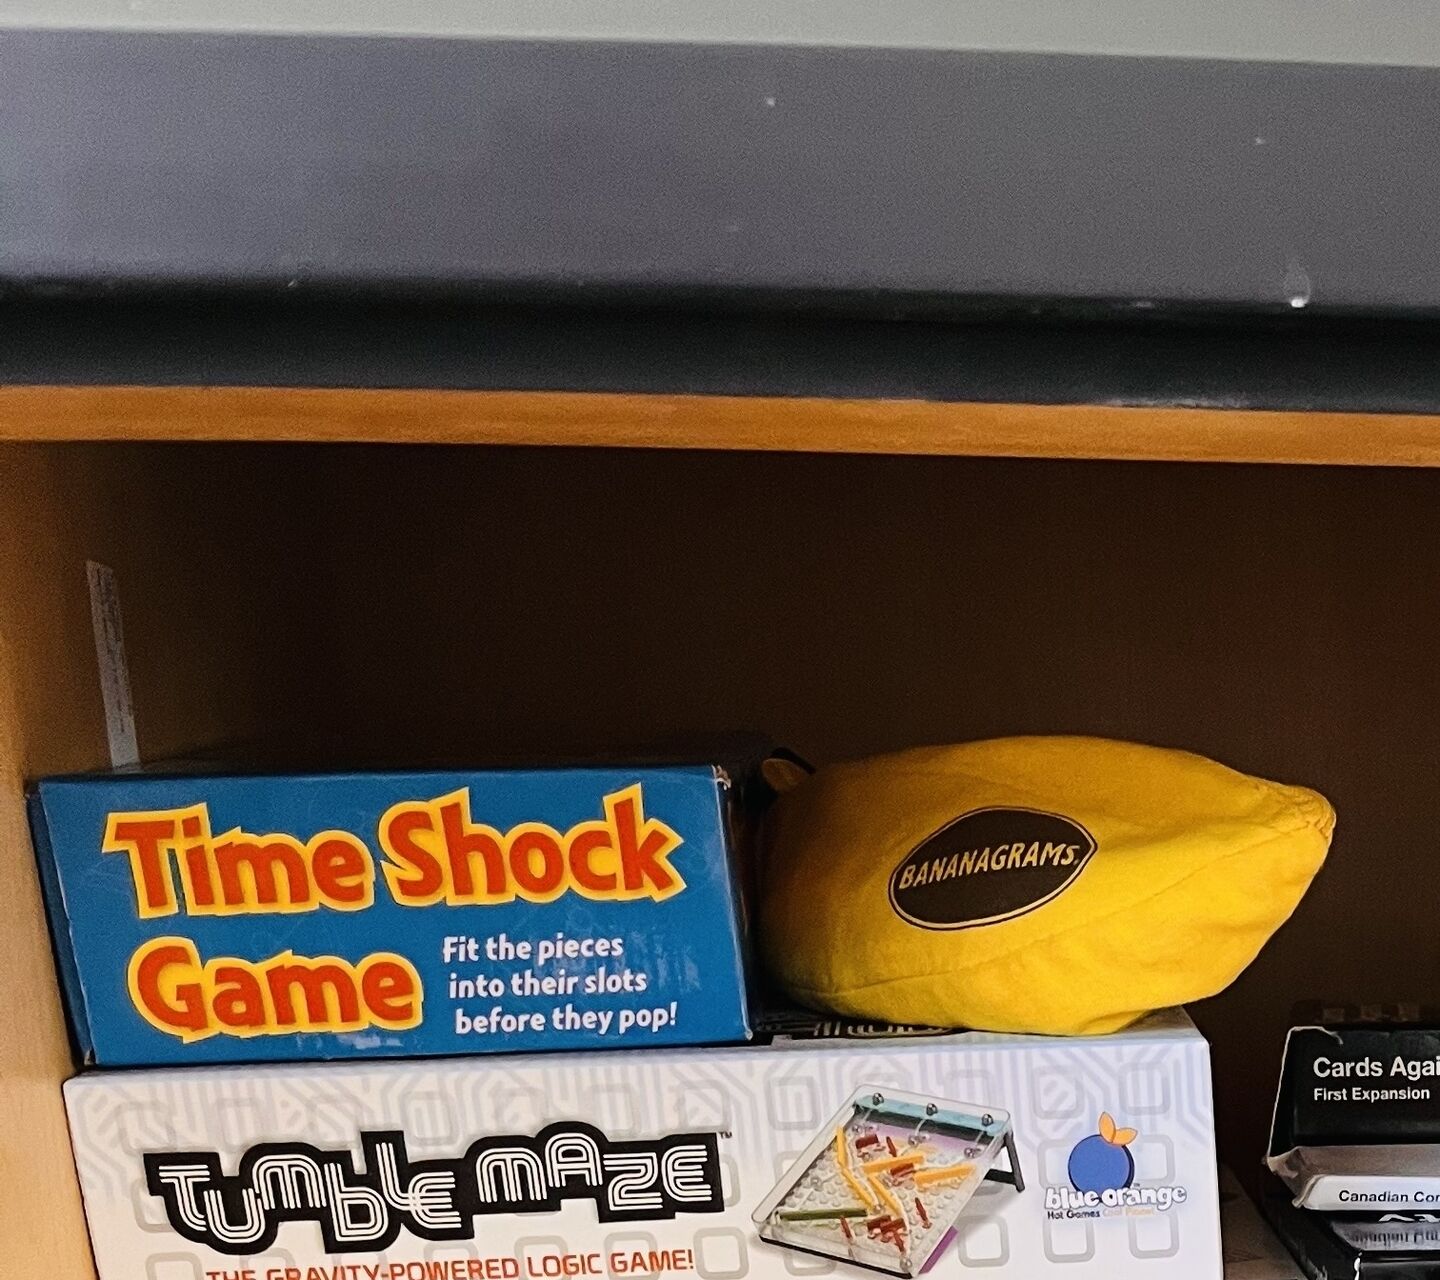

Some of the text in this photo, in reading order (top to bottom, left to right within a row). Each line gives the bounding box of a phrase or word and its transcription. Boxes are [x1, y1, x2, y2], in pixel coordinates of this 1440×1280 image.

[104, 783, 686, 918] Time Shock
[899, 842, 1080, 890] BANANAGRAMS
[442, 934, 624, 967] Fit the pieces
[128, 936, 423, 1043] Game
[449, 968, 647, 999] into their slots
[455, 1002, 677, 1035] before they pop!
[1313, 1057, 1383, 1078] Cards
[1314, 1086, 1430, 1102] First Expansion
[1045, 1186, 1187, 1211] blue orange
[1338, 1190, 1410, 1204] Canadian
[528, 1253, 601, 1277] LOGIC
[610, 1248, 694, 1273] GAME!
